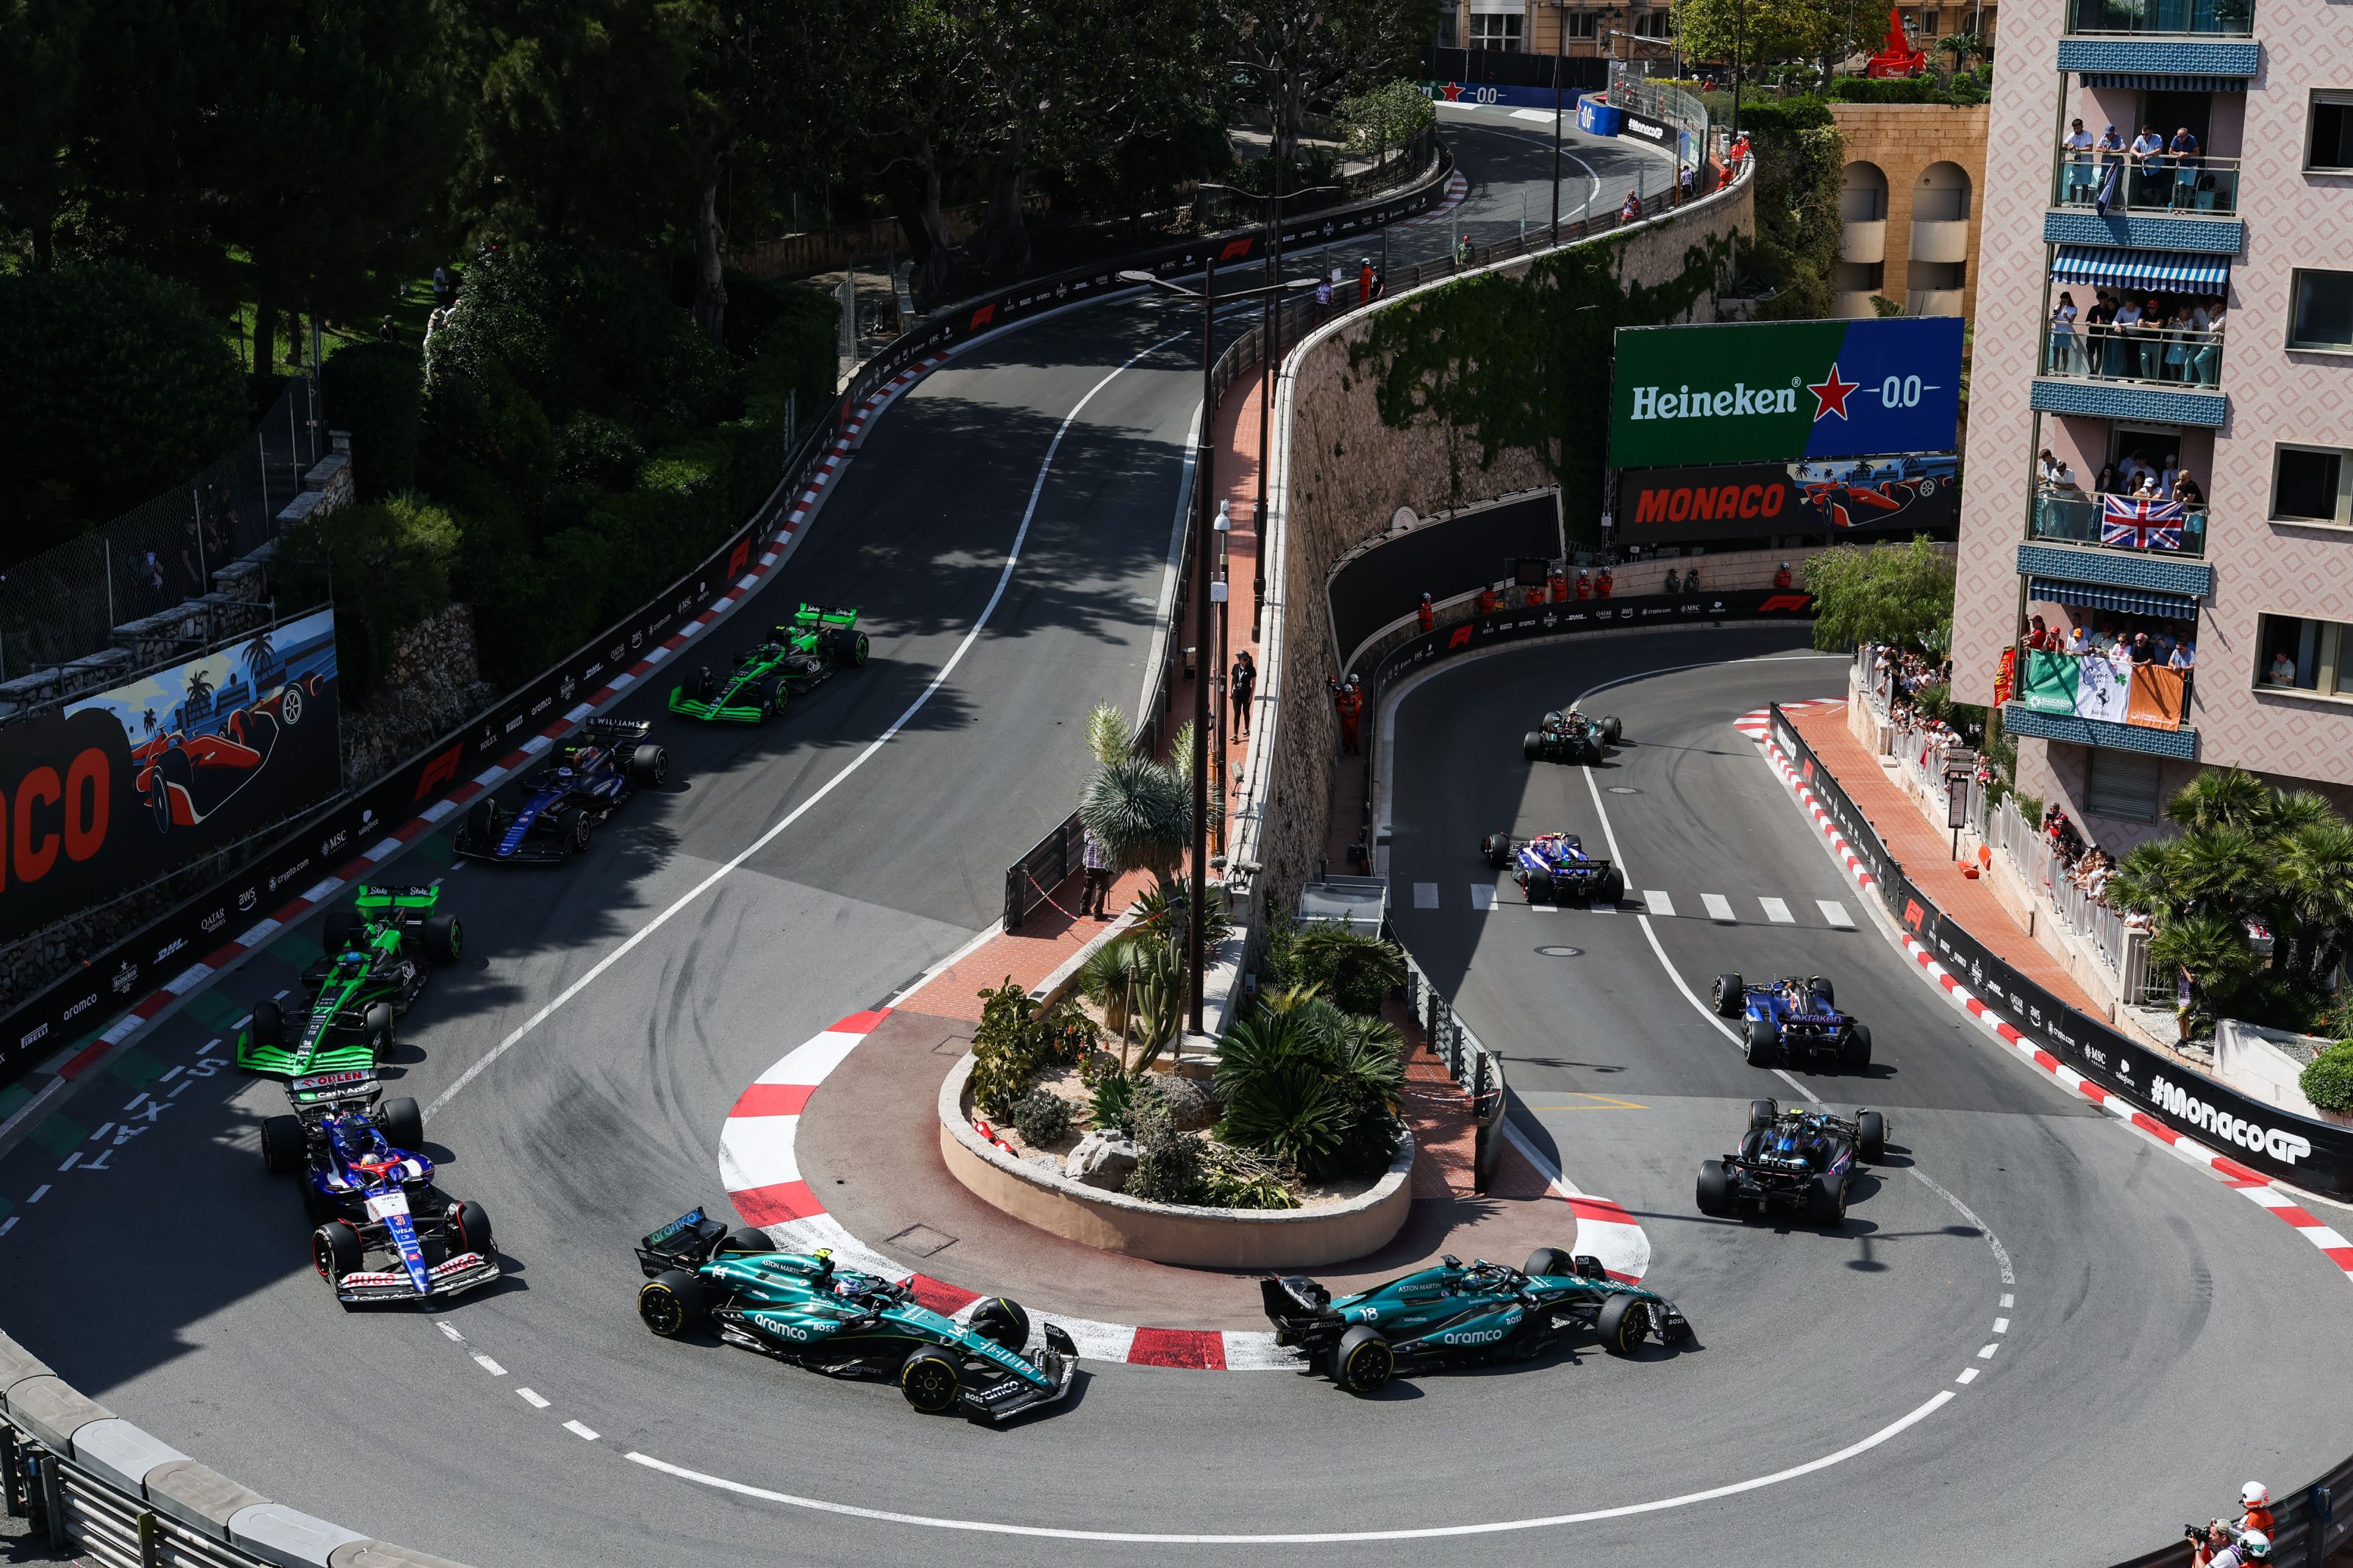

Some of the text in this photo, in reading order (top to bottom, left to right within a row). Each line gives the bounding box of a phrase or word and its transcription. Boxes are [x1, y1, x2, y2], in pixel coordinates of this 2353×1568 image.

[1635, 483, 1785, 523] MONACO
[532, 696, 551, 715] aramco
[2041, 698, 2073, 706] ELLICKSON
[507, 715, 523, 733] PIRELLI
[597, 717, 640, 728] WILLIAMS
[1548, 726, 1577, 734] INEOS
[480, 735, 497, 751] ROLEX
[358, 818, 379, 837] salesforce
[330, 830, 347, 850] MSC
[277, 858, 309, 884] crypto.com
[238, 887, 256, 906] aws
[201, 908, 225, 930] QATAR
[155, 937, 187, 964] DHL
[113, 969, 138, 988] Heineken
[63, 994, 97, 1020] aramco
[2010, 992, 2024, 1010] QATAR
[1802, 1014, 1841, 1023] kraken
[2030, 1005, 2040, 1021] aws
[21, 1023, 49, 1049] PIRELLI
[2054, 1027, 2075, 1047] crypto.com
[2091, 1047, 2106, 1064] MSC
[318, 1071, 363, 1084] ORLEN
[2115, 1070, 2135, 1087] salesforce
[347, 1086, 368, 1094] App
[1735, 1156, 1800, 1170] ALPINE
[393, 1215, 405, 1226] 3
[651, 1211, 699, 1242] aramco
[438, 1255, 478, 1275] HUGO
[713, 1265, 730, 1279] 14
[761, 1259, 780, 1269] ASTON
[349, 1274, 396, 1286] HUGO
[1399, 1282, 1441, 1293] ASTON MARTIN
[810, 1296, 835, 1306] SentinelOne
[1360, 1307, 1379, 1322] 18
[1506, 1314, 1522, 1325] BOSS
[754, 1314, 807, 1341] aramco
[813, 1324, 836, 1333] BOSS
[1046, 1325, 1060, 1333] AVA
[1444, 1329, 1502, 1345] aramco
[965, 1393, 983, 1403] BOSS
